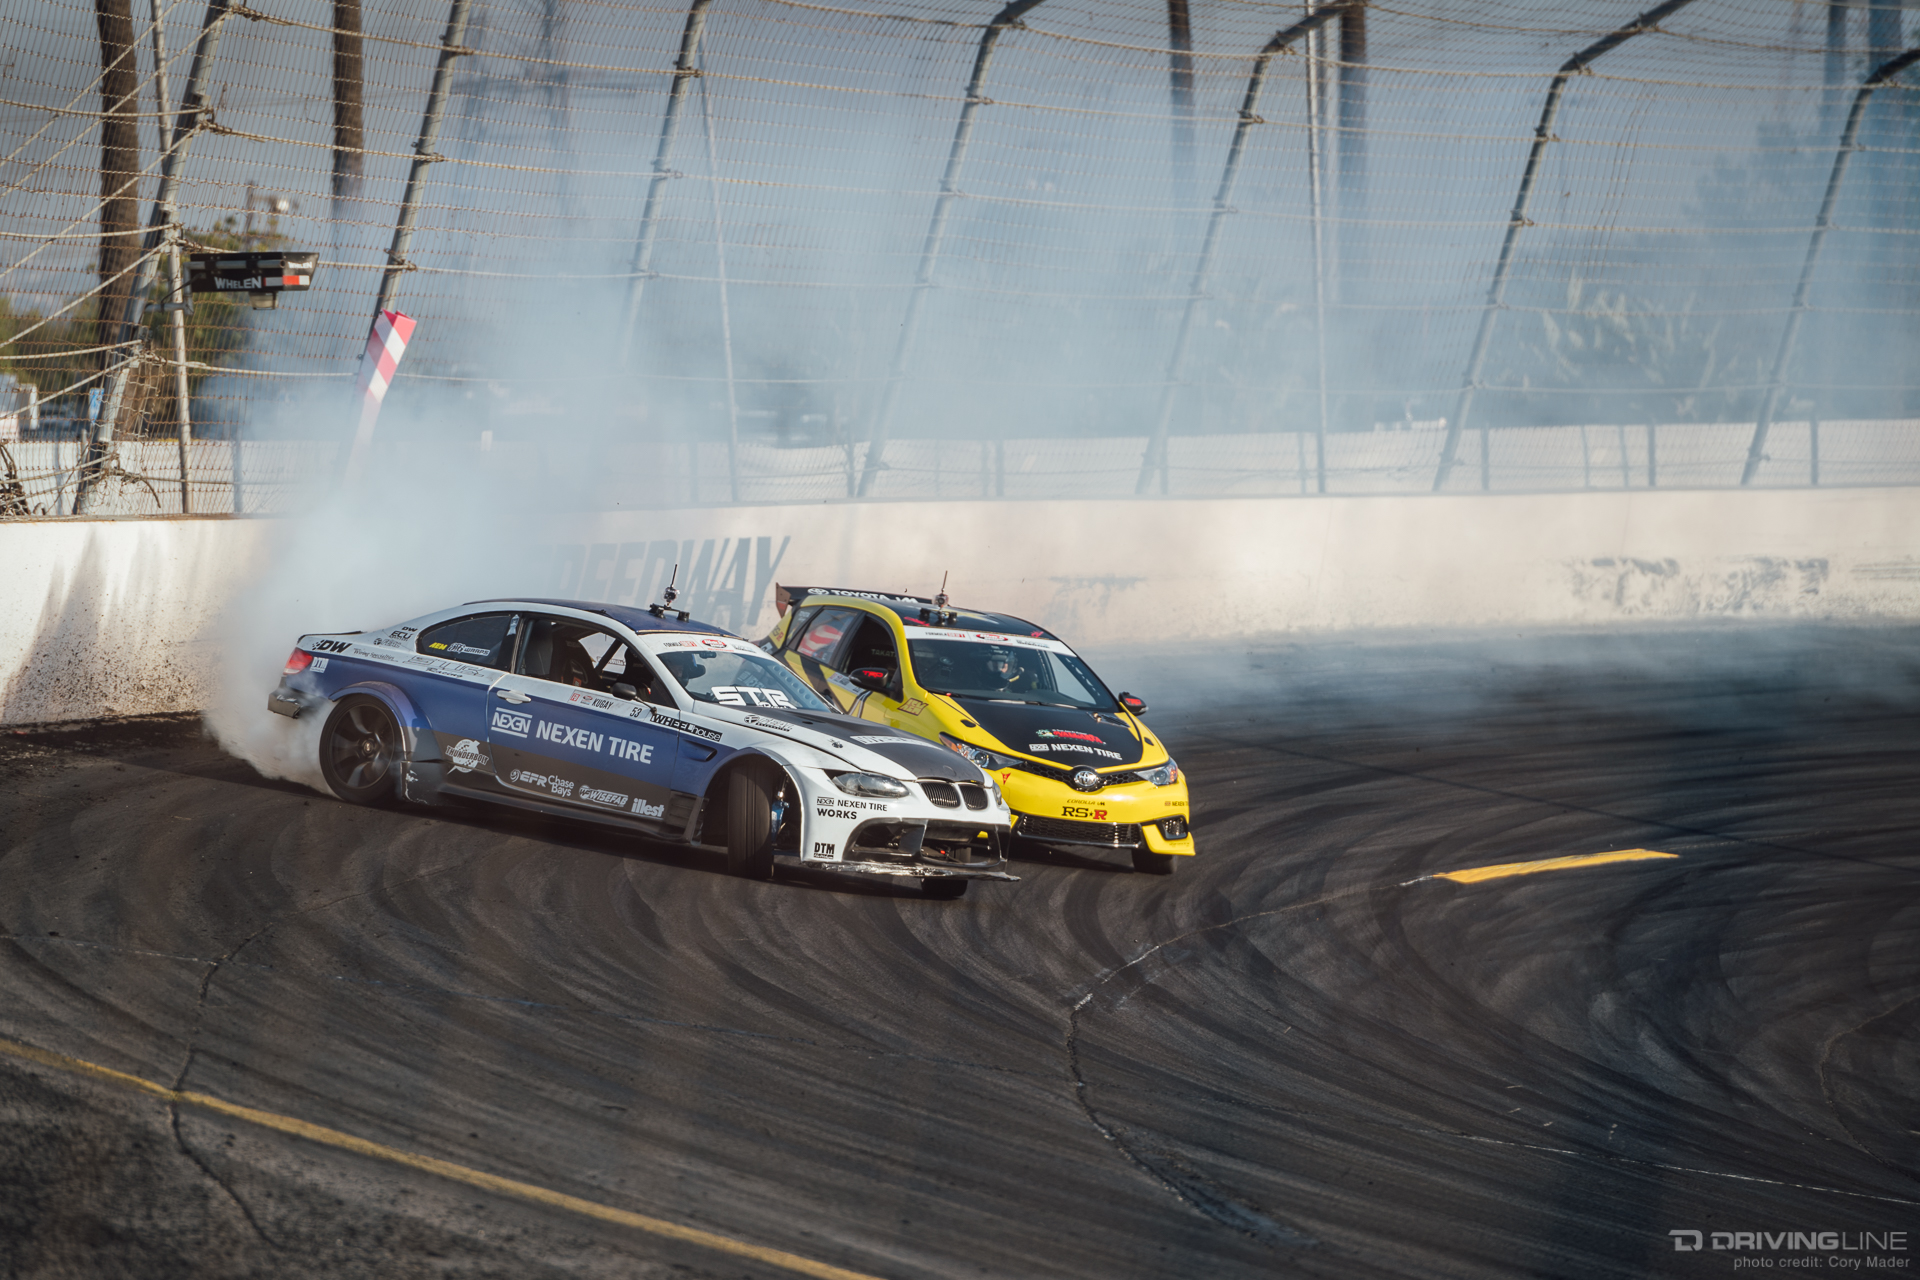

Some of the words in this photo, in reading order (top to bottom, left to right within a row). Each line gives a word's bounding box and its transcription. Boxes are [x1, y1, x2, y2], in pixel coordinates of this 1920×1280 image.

[287, 261, 313, 269] WHELEN
[213, 276, 262, 289] WHELEN
[831, 590, 891, 601] TOYOTA
[318, 640, 353, 654] DW
[429, 642, 448, 651] AEM
[862, 670, 884, 678] TRD
[592, 698, 614, 710] KUGAY
[629, 706, 643, 719] 53
[491, 710, 532, 735] NEXEN
[535, 719, 604, 752] NEXEN
[608, 736, 655, 764] TIRE
[446, 746, 489, 765] THUNDERBOLT
[1051, 744, 1094, 754] NEXEN
[1094, 748, 1123, 760] TIRE
[519, 771, 548, 787] EFR
[548, 775, 575, 789] Chase
[551, 783, 572, 797] Bays
[590, 789, 629, 806] WISEFAB
[631, 798, 665, 817] illest
[837, 799, 867, 809] NEXEN
[869, 802, 888, 812] TIRE
[816, 808, 858, 820] WORKS
[814, 842, 836, 855] DTM
